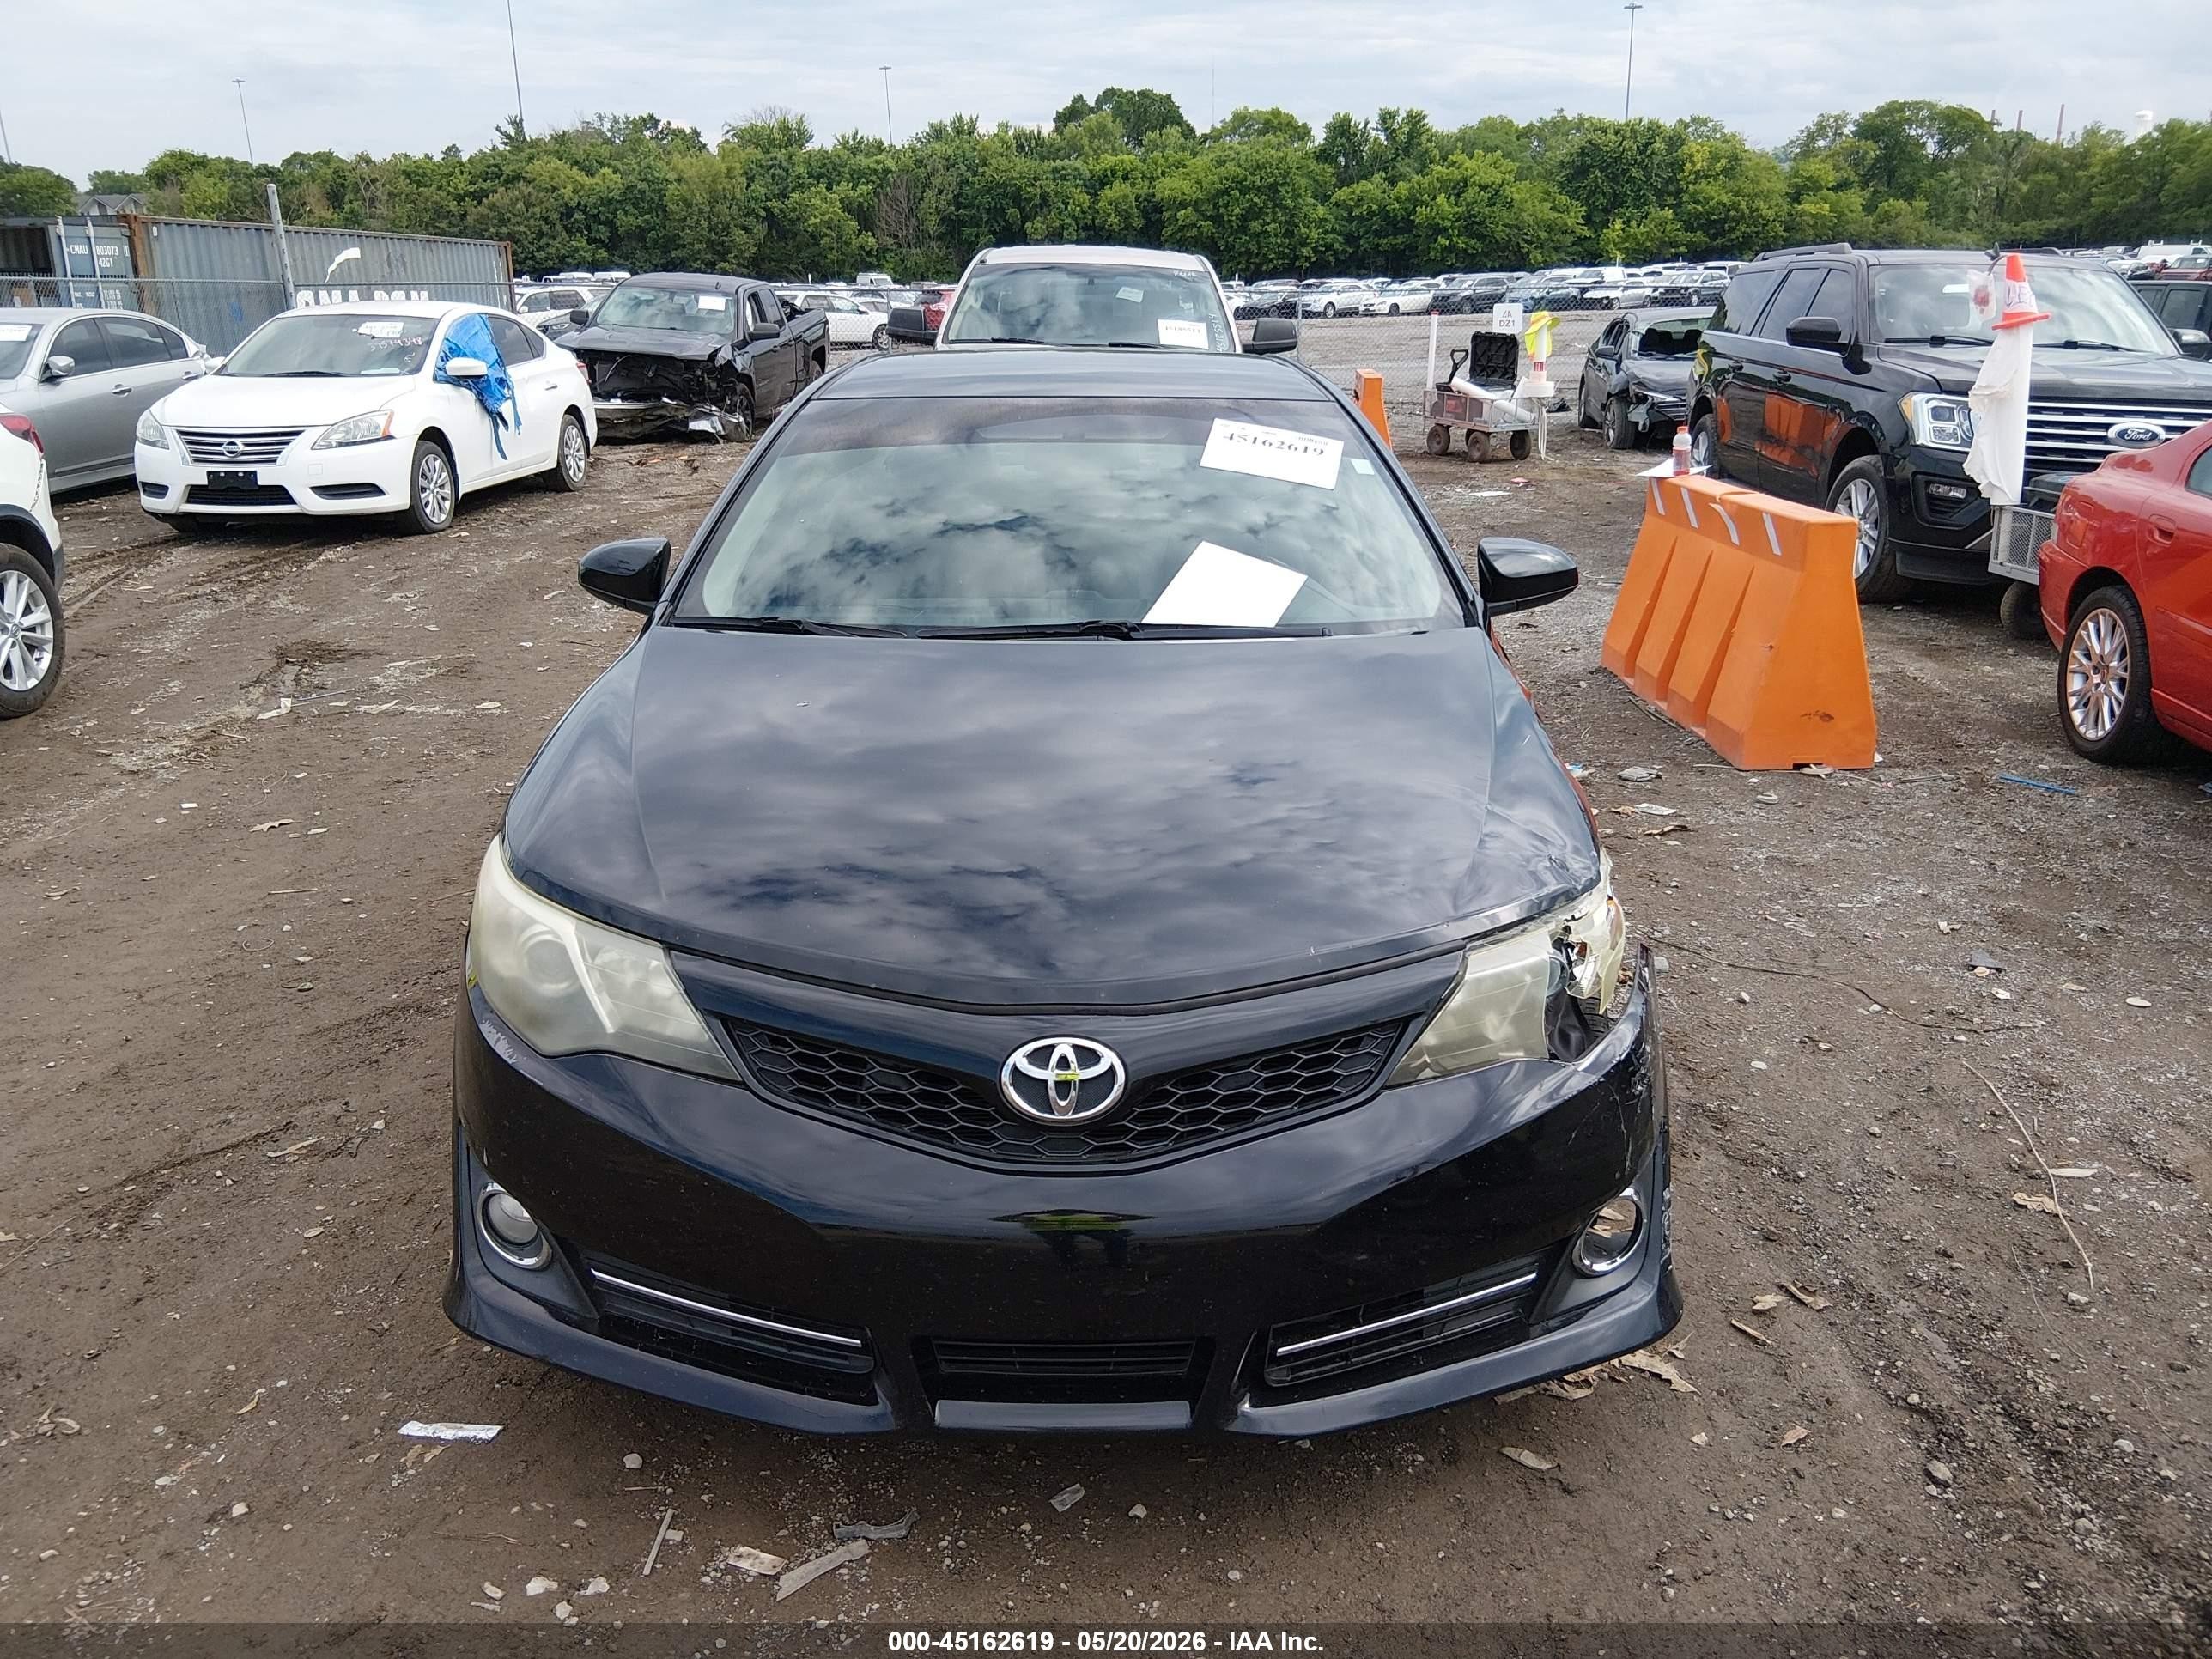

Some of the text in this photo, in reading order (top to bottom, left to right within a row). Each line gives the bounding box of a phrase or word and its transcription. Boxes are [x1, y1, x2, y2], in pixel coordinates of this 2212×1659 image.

[70, 245, 88, 254] CMAU
[95, 246, 118, 255] 803073
[2124, 428, 2153, 441] Ford
[1223, 432, 1324, 456] 45162619
